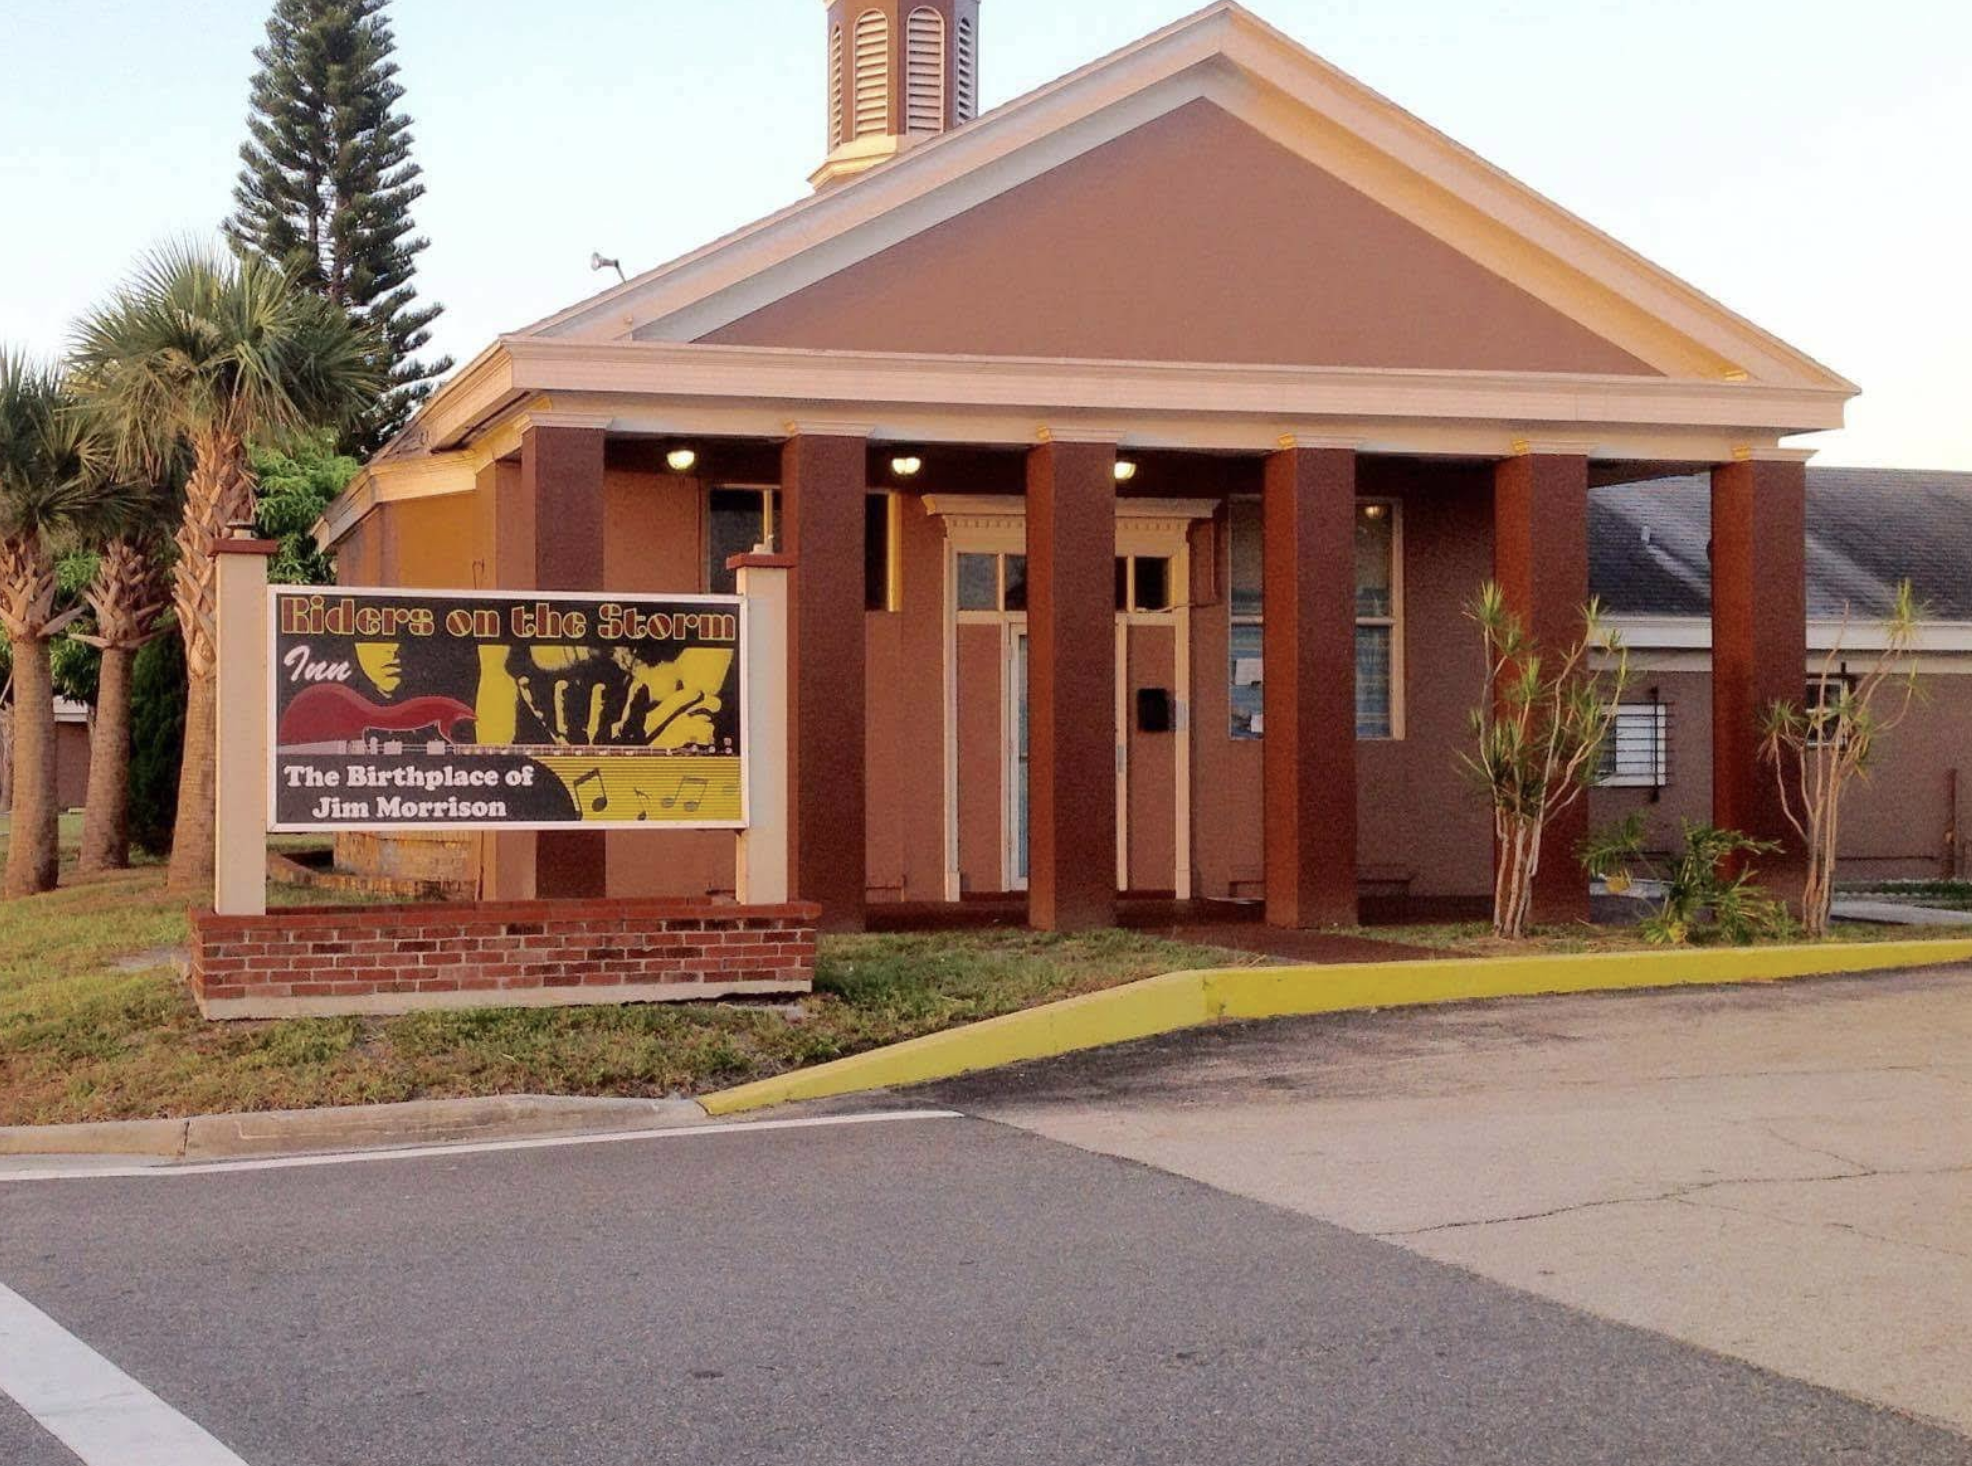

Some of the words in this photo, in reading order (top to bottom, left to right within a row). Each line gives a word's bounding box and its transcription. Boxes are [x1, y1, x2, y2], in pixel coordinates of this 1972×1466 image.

[280, 595, 435, 637] Riders
[446, 609, 500, 637] on
[511, 602, 587, 640] the
[598, 602, 736, 642] Storm
[283, 644, 352, 682] Inn
[284, 765, 339, 788] The
[345, 765, 501, 791] Birthplace
[505, 765, 534, 788] of
[312, 798, 373, 819] Jim
[376, 798, 507, 819] Morrison
